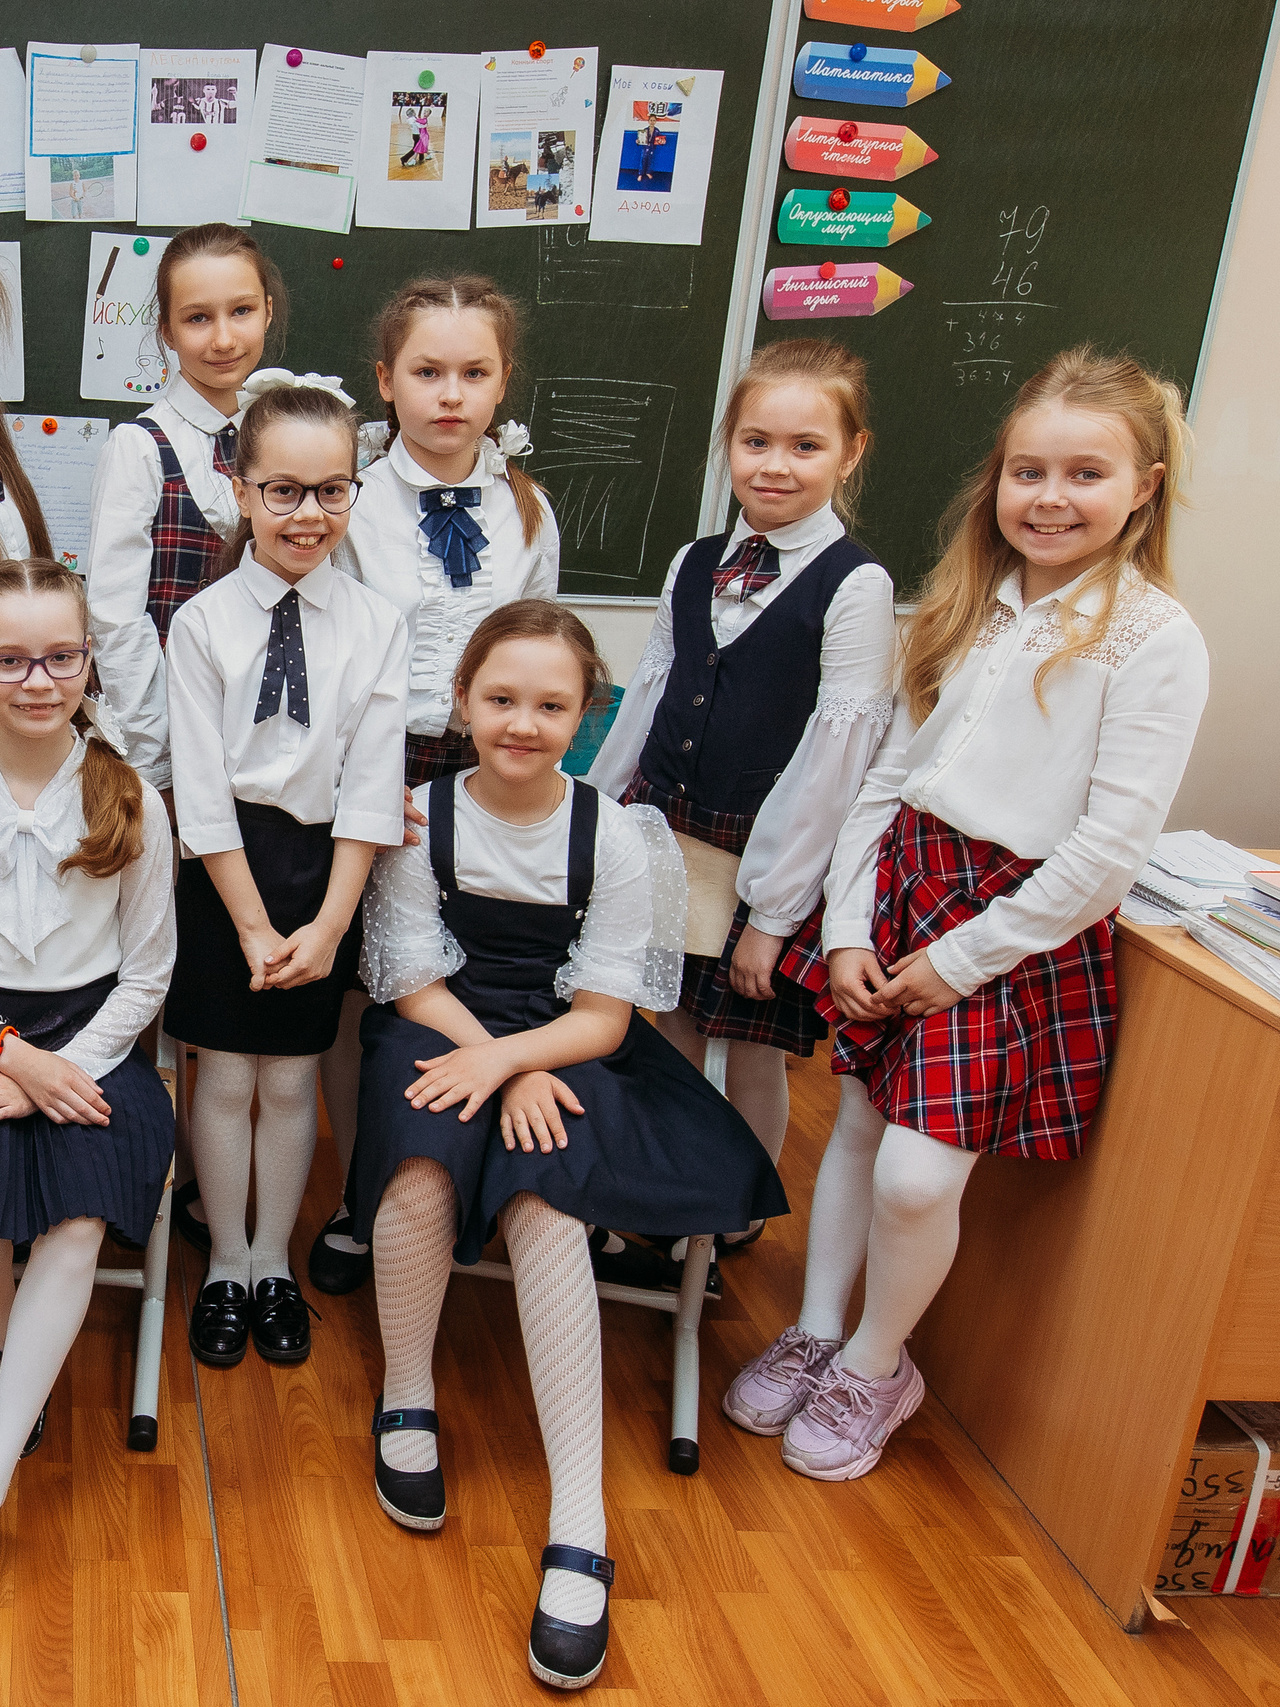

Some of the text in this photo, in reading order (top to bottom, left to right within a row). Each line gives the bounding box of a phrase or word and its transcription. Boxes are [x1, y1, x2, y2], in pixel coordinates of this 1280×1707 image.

[805, 58, 914, 84] Математика
[821, 150, 872, 165] чтение
[617, 200, 671, 215] ДЗЮДО
[788, 203, 894, 228] Окружающий
[821, 224, 856, 241] мир
[999, 205, 1050, 256] 79
[777, 274, 869, 293] Английский
[991, 260, 1039, 299] 46
[93, 300, 159, 326] ИСКУСС
[803, 292, 841, 312] язык
